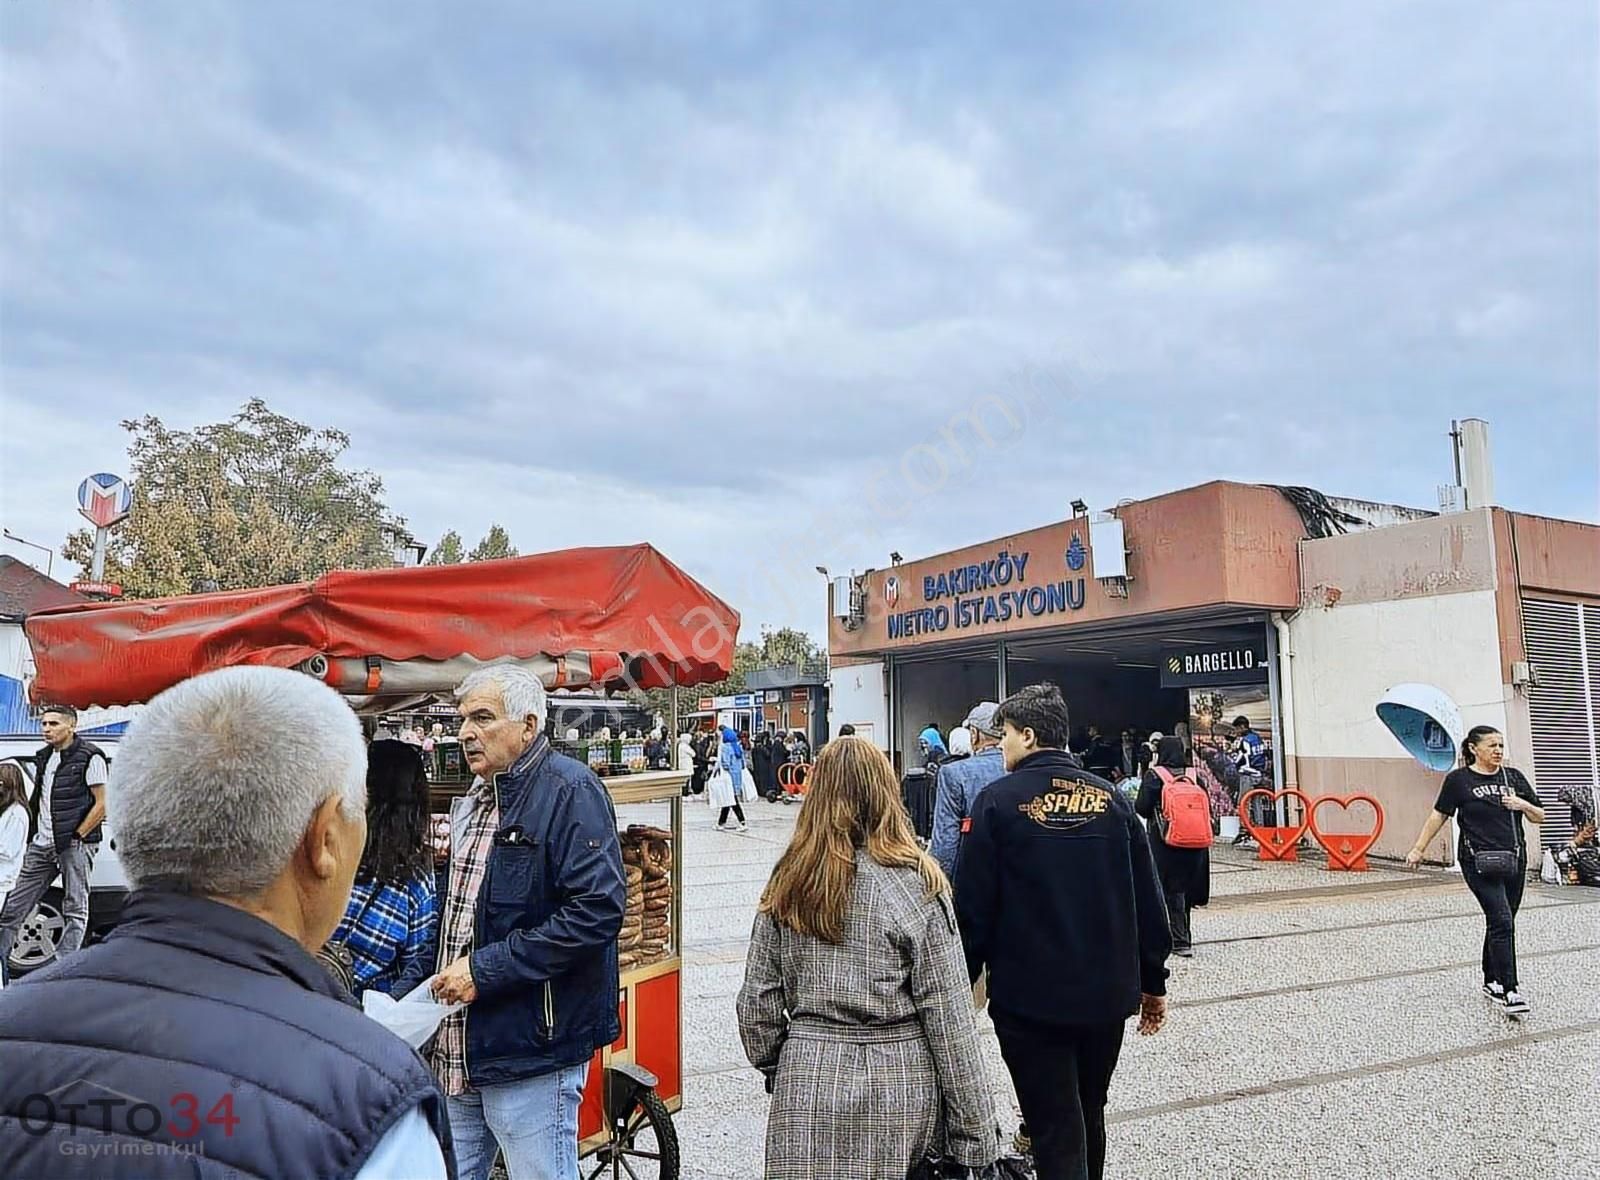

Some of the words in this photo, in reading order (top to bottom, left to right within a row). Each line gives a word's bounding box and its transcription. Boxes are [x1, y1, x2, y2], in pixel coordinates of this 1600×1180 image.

[923, 551, 1029, 602] BAKIRKÖY
[887, 604, 950, 640] METRO
[954, 578, 1086, 628] İSTASYONU
[1185, 650, 1253, 673] BARGELLO
[1042, 792, 1108, 813] SPACE
